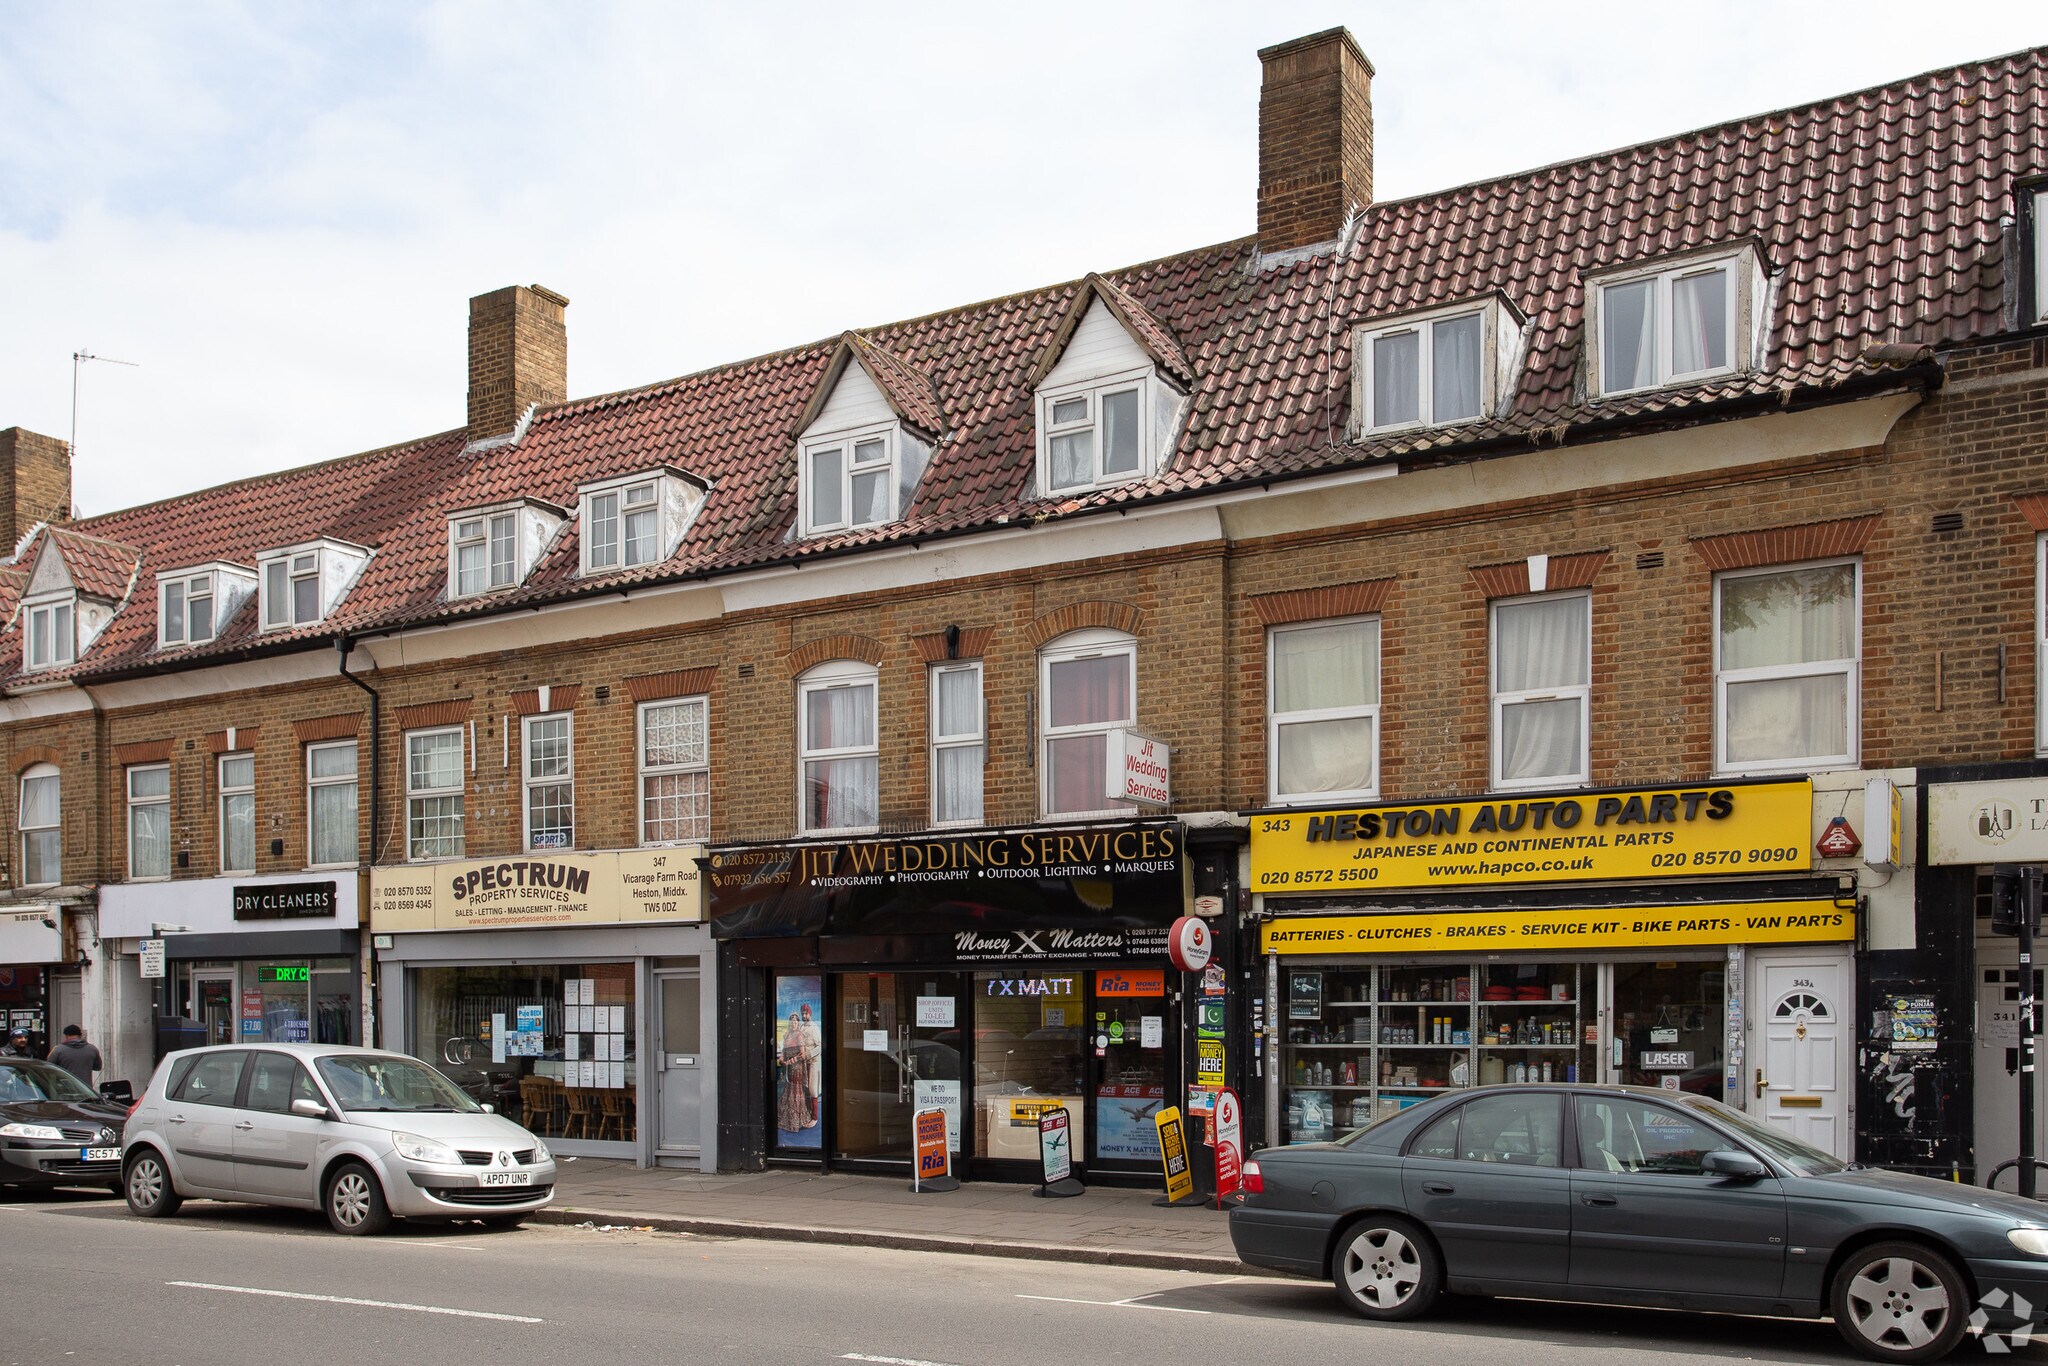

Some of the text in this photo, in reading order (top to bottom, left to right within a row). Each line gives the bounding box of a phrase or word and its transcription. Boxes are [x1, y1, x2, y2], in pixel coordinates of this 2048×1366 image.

[1141, 741, 1153, 757] Jit
[1127, 754, 1167, 783] Wedding
[1127, 778, 1167, 801] Services
[2030, 798, 2048, 813] T
[1262, 790, 1734, 842] 343 HESTON AUTO PARTS
[534, 834, 565, 844] SPORTS
[1353, 831, 1674, 860] JAPANESE AND CONTINENTAL PARTS
[653, 857, 666, 867] 347
[724, 854, 740, 866] 020
[743, 853, 765, 865] 8572
[800, 828, 1174, 886] JIT WEDDING SERVICES
[1651, 847, 1798, 868] 020 8570 9090
[1428, 855, 1594, 877] www.hapco.co.uk
[452, 862, 590, 900] SPECTRUM
[623, 870, 698, 885] Vicarage Farm Road
[724, 872, 791, 886] 07932 656 557
[817, 861, 1174, 887] VIDEOGRAPHY PHOTOGRAPHY OUTDOOR LIGHTING MARQUEES
[1260, 867, 1378, 885] 020 8572 5500
[384, 886, 432, 896] 020 8570 5352
[469, 888, 569, 906] PROPERTY SERVICES
[633, 887, 688, 898] Heston, Middx.
[236, 892, 329, 910] DRY CLEANERS
[384, 900, 432, 910] 020 8569 4345
[644, 903, 660, 912] TW5
[455, 904, 588, 917] SALES LETTING MANAGEMENT FINANCE
[1270, 914, 1843, 942] BATTERIES CLUTCHES BRAKES SERVICE KIT BIKE PARTS VAN PARTS
[142, 942, 146, 950] P
[954, 928, 1123, 954] Money X Matters
[276, 968, 297, 980] DRY
[999, 978, 1072, 996] X MATT
[1101, 974, 1130, 992] Ria
[244, 996, 260, 1004] Trouser
[244, 1008, 261, 1016] Shorten
[244, 1021, 261, 1031] £7.00
[1200, 1048, 1222, 1058] MONEY
[1645, 1053, 1688, 1064] LASER
[1200, 1058, 1222, 1072] HERE
[920, 1096, 930, 1104] VISA
[919, 1124, 943, 1133] MONEY
[920, 1132, 944, 1140] TRANSFER
[89, 1150, 113, 1158] SC57
[922, 1150, 944, 1170] Ria
[1169, 1155, 1185, 1175] HERE
[486, 1174, 527, 1184] AP07 UNR
